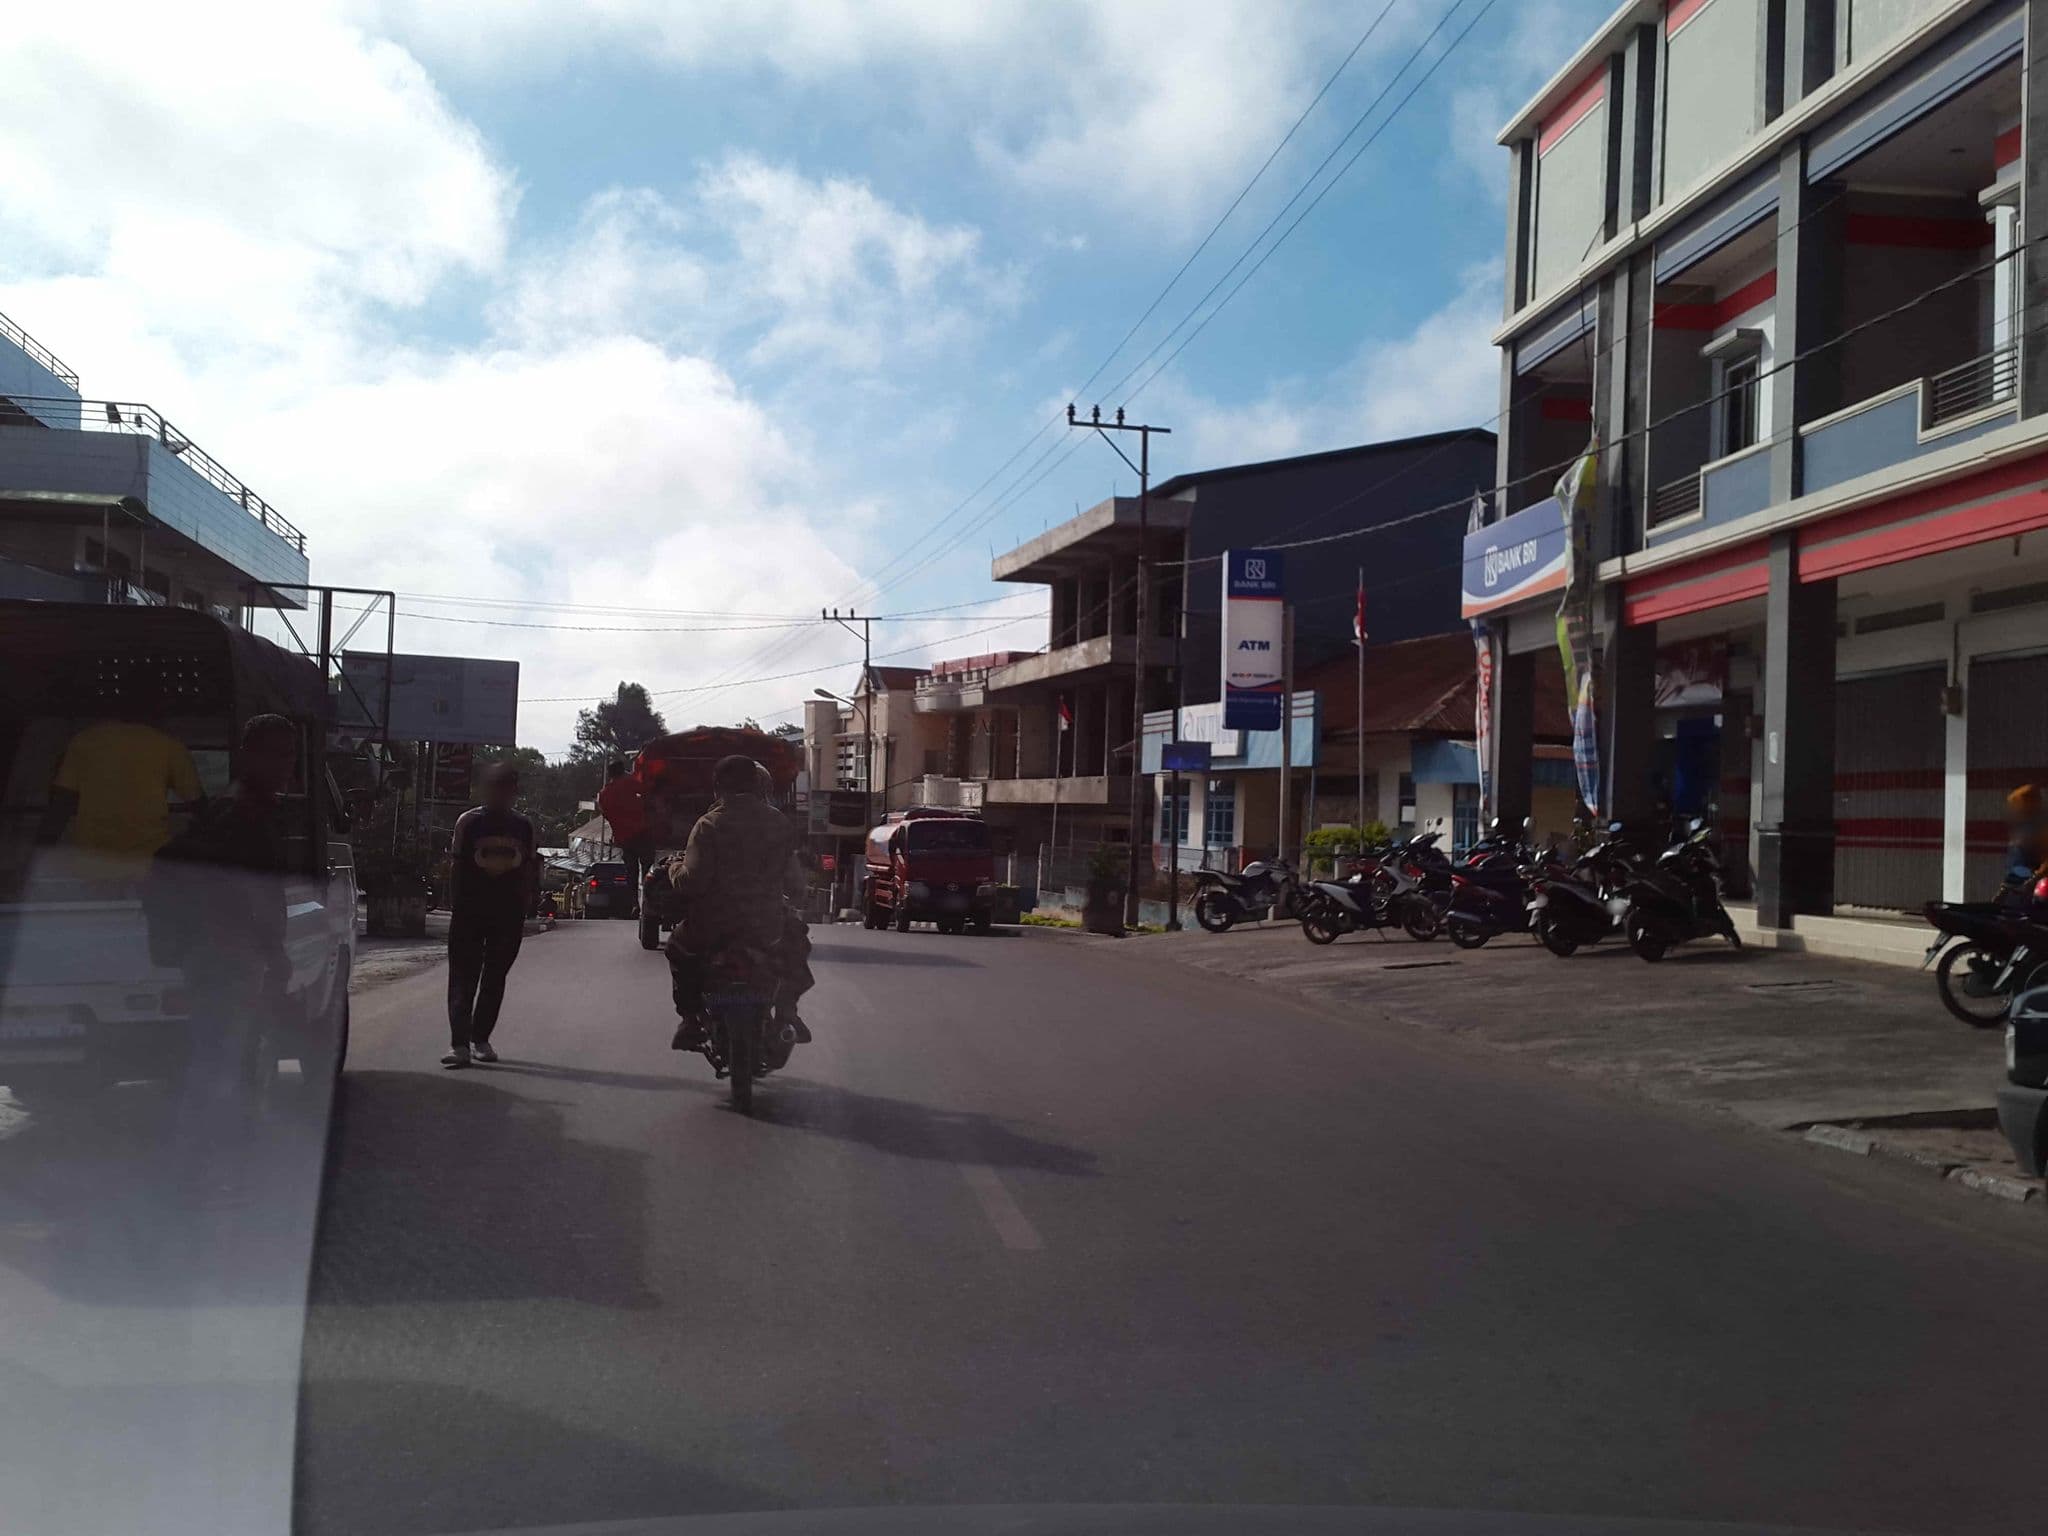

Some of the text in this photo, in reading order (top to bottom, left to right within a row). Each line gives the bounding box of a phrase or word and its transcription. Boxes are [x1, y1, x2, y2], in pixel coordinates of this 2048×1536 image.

[1497, 539, 1537, 574] BANK BRI
[1233, 580, 1276, 589] BANK BRI
[1237, 640, 1270, 652] ATM
